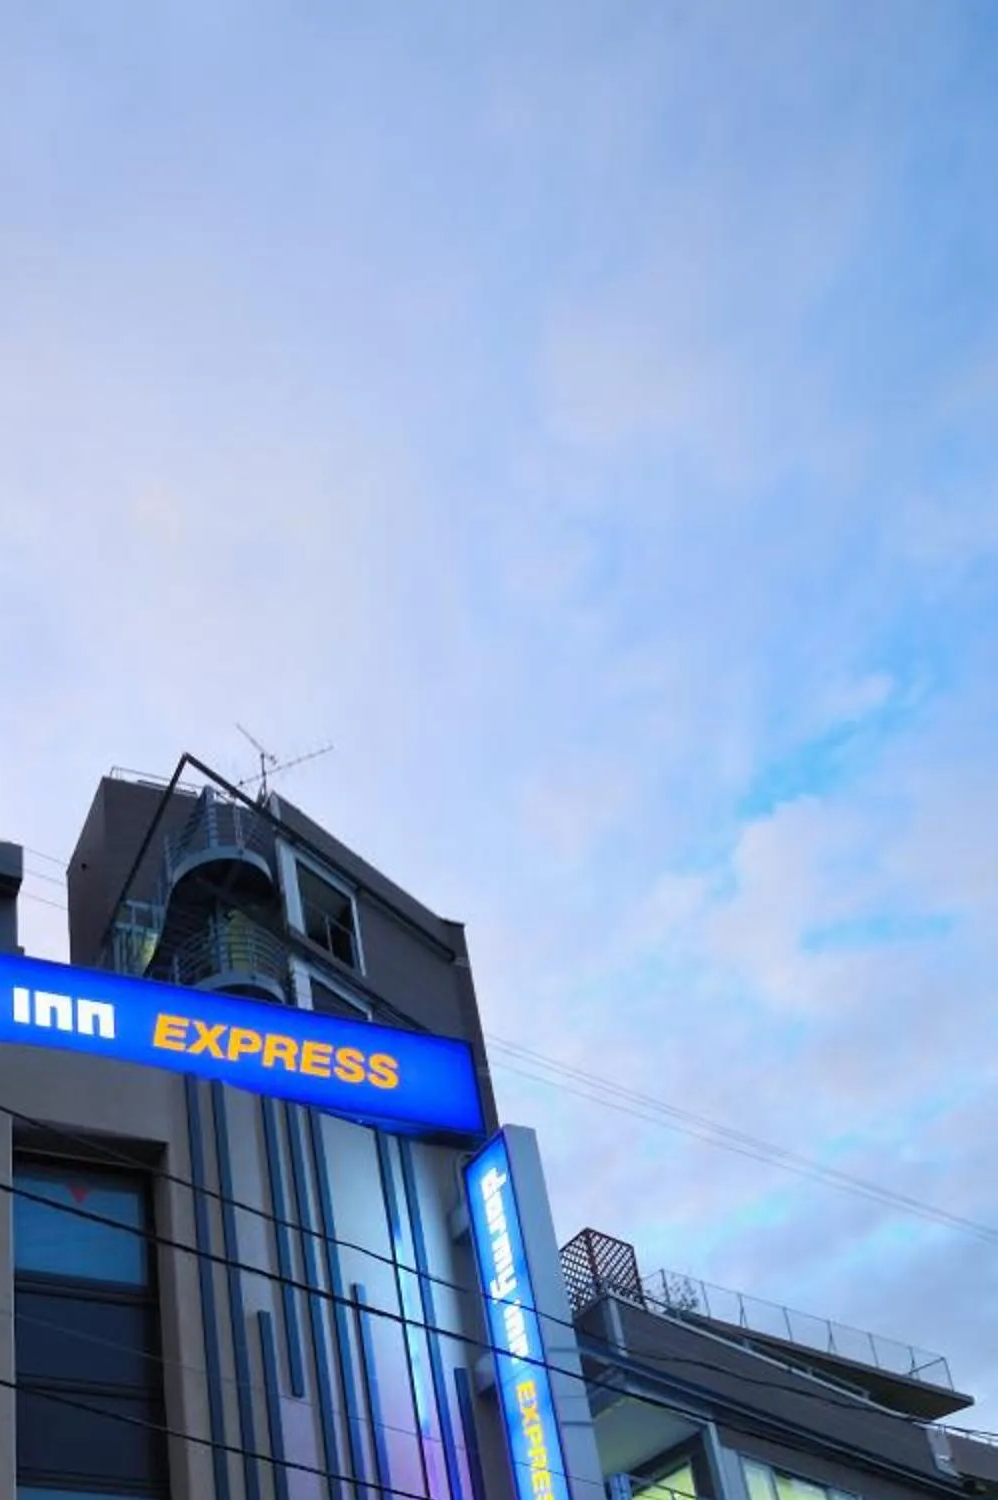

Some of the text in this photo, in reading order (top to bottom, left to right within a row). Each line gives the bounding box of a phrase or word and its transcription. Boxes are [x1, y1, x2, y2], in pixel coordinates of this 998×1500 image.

[14, 988, 114, 1038] inn
[153, 1014, 399, 1089] EXPRESS
[481, 1167, 516, 1300] dormy
